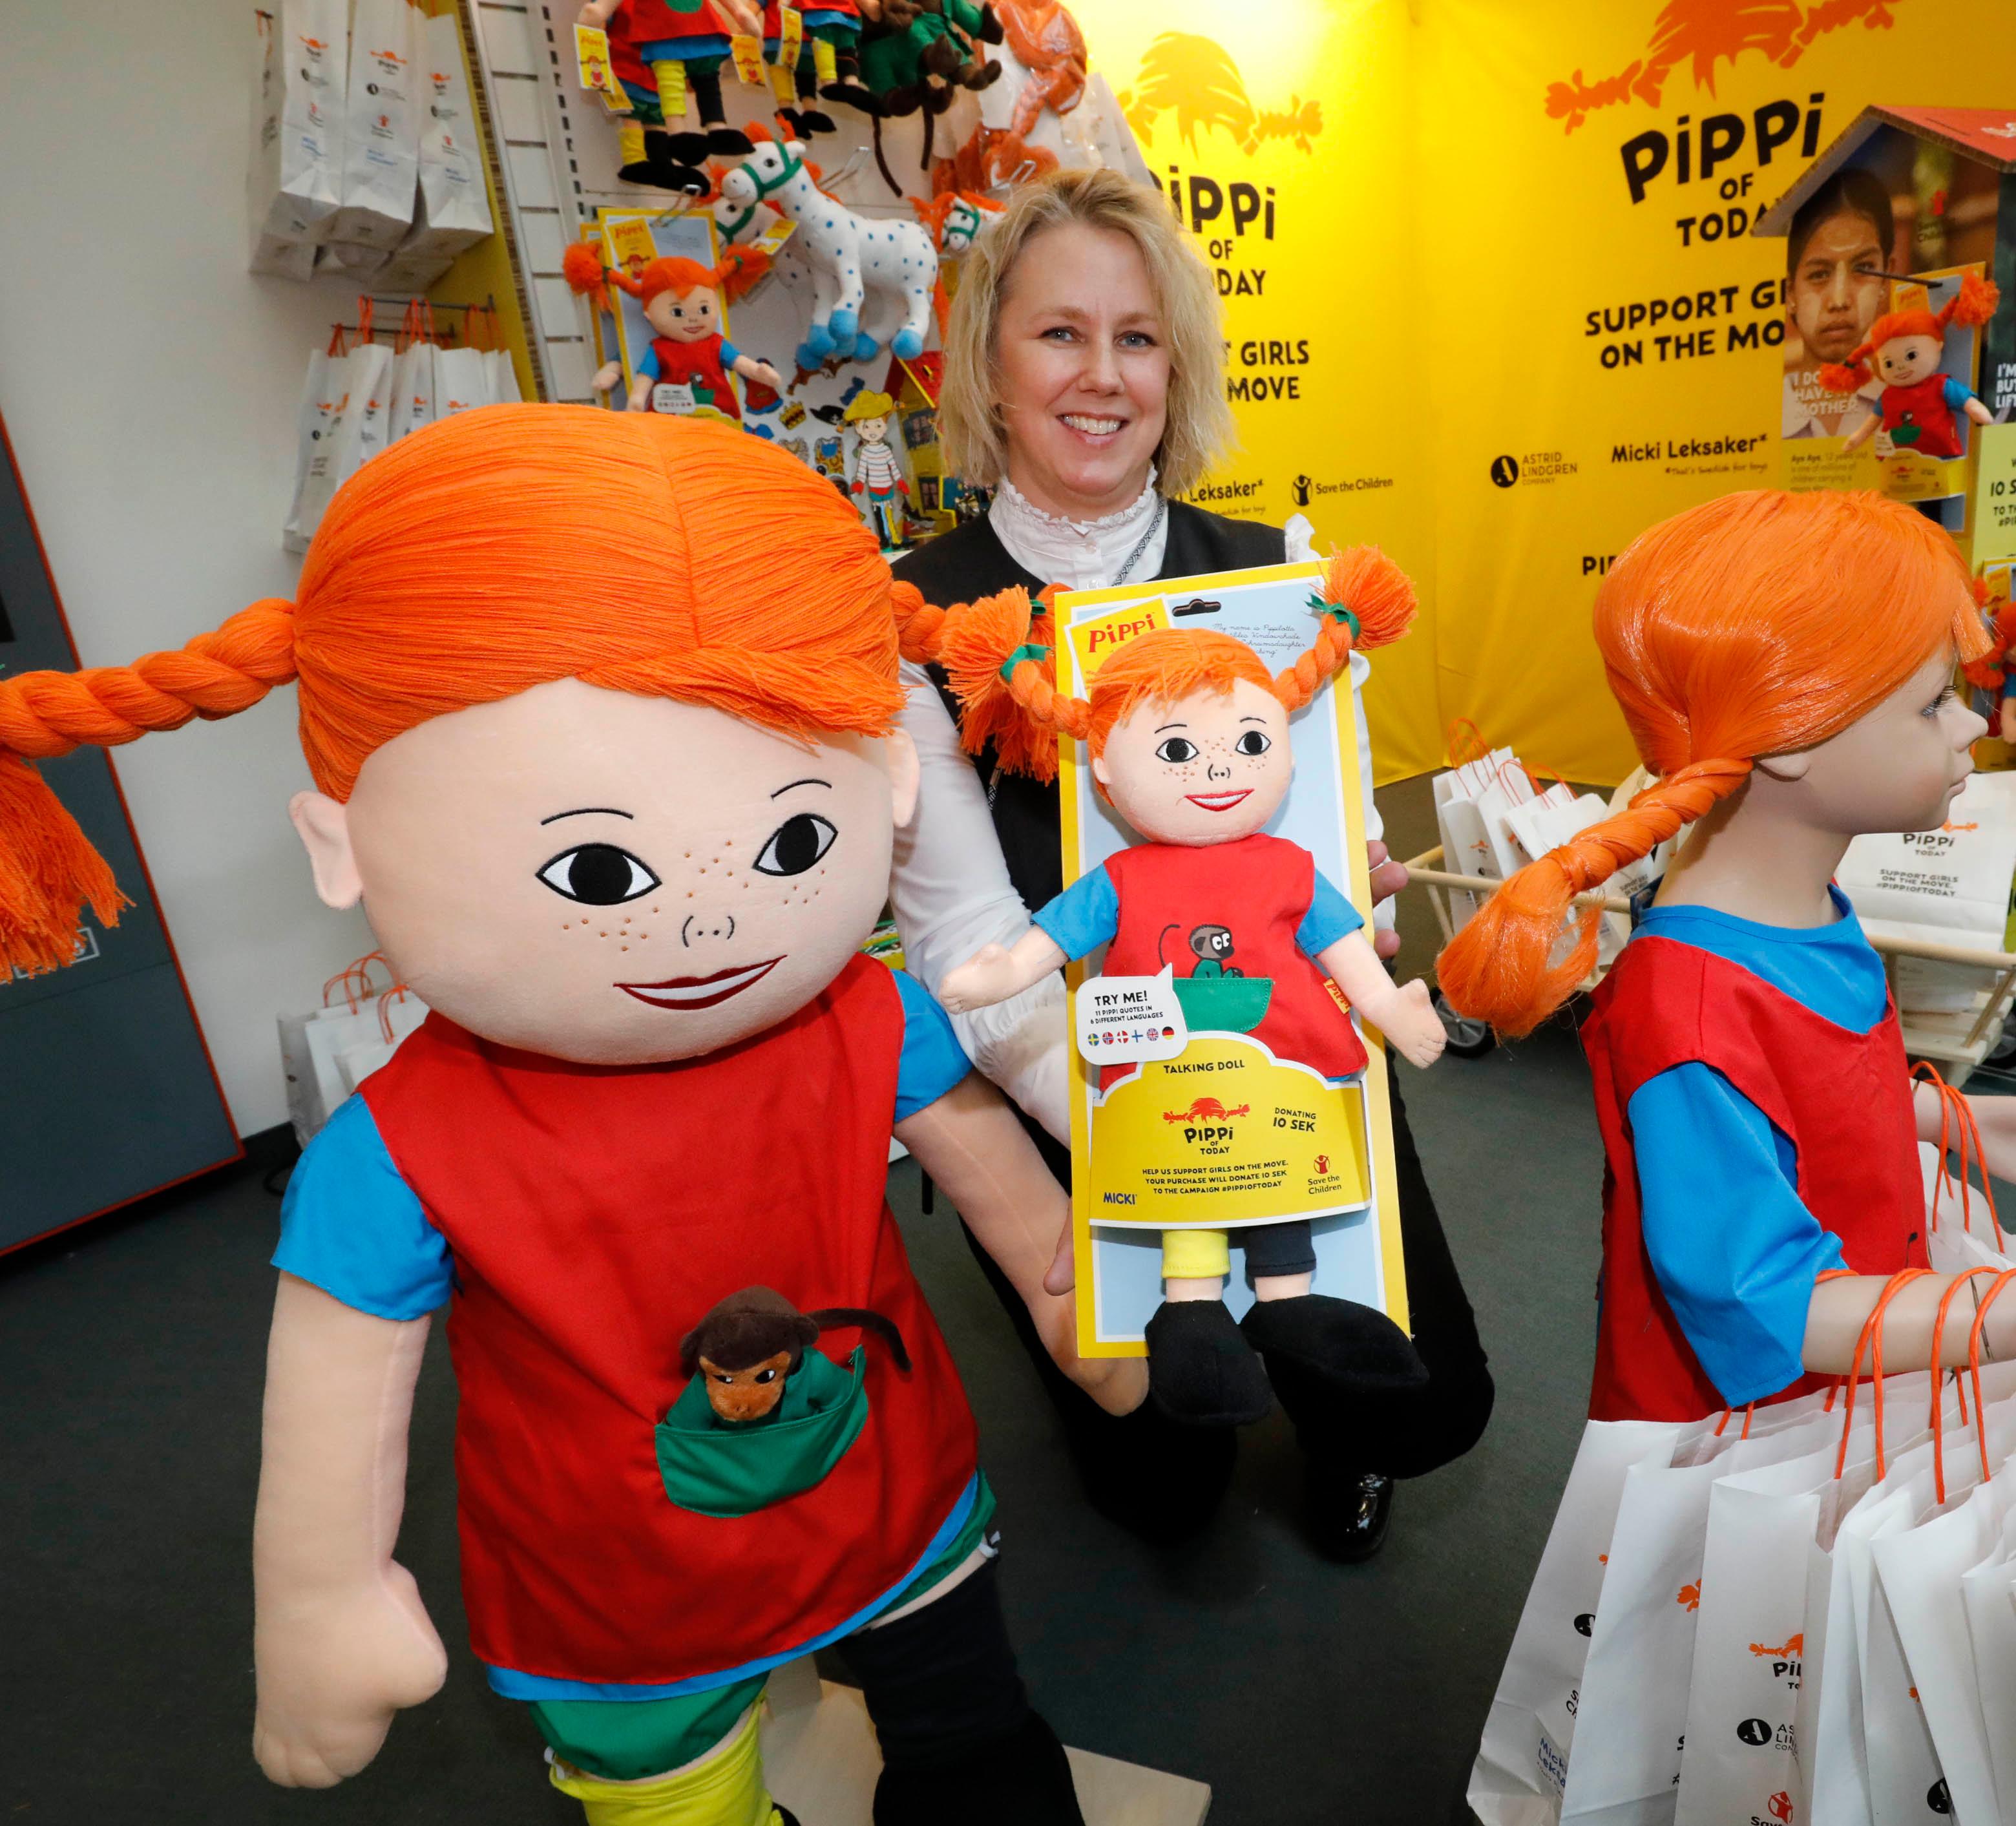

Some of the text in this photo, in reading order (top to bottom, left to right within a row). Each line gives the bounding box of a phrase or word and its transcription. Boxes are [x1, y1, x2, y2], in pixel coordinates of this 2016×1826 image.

[1621, 92, 1825, 205] PiPPi
[1719, 173, 1754, 201] OF
[1209, 239, 1234, 260] OF
[1217, 268, 1266, 297] DAY
[1585, 285, 1739, 337] SUPPORT
[1600, 319, 1785, 370] ON THE MO
[1241, 339, 1310, 366] GIRLS
[1228, 376, 1301, 403] MOVE
[1522, 451, 1562, 465] ASTRID
[1612, 442, 1661, 463] Micki
[1522, 463, 1578, 477] LINDGREN
[1316, 476, 1393, 495] Save the Children
[1088, 613, 1157, 653] PiPPi
[1213, 623, 1226, 632] My
[1903, 832, 1955, 847] PiPPi
[1879, 868, 1960, 883] SUPPORT GIRLS
[1876, 882, 1956, 897] #PIPPIOFTODAY
[1095, 990, 1148, 1007] TRY ME!
[1120, 1005, 1144, 1014] QUOTES
[1095, 1016, 1126, 1024] DIFFERENT
[1126, 1011, 1164, 1021] LANGUAGES
[1164, 1059, 1245, 1074] TALKING DOLL
[1275, 1107, 1316, 1120] DONATING
[1273, 1117, 1316, 1132] 10 SEK
[1200, 1146, 1230, 1155] TODAY
[1264, 1160, 1288, 1169] MOVE.
[1229, 1173, 1260, 1182] DONATE
[1307, 1175, 1340, 1186] Save the
[1222, 1181, 1282, 1192] #PIPPIOFTODAY
[1308, 1184, 1342, 1195] Children
[1103, 1191, 1136, 1206] MICKI
[1538, 1747, 1566, 1789] Leksa
